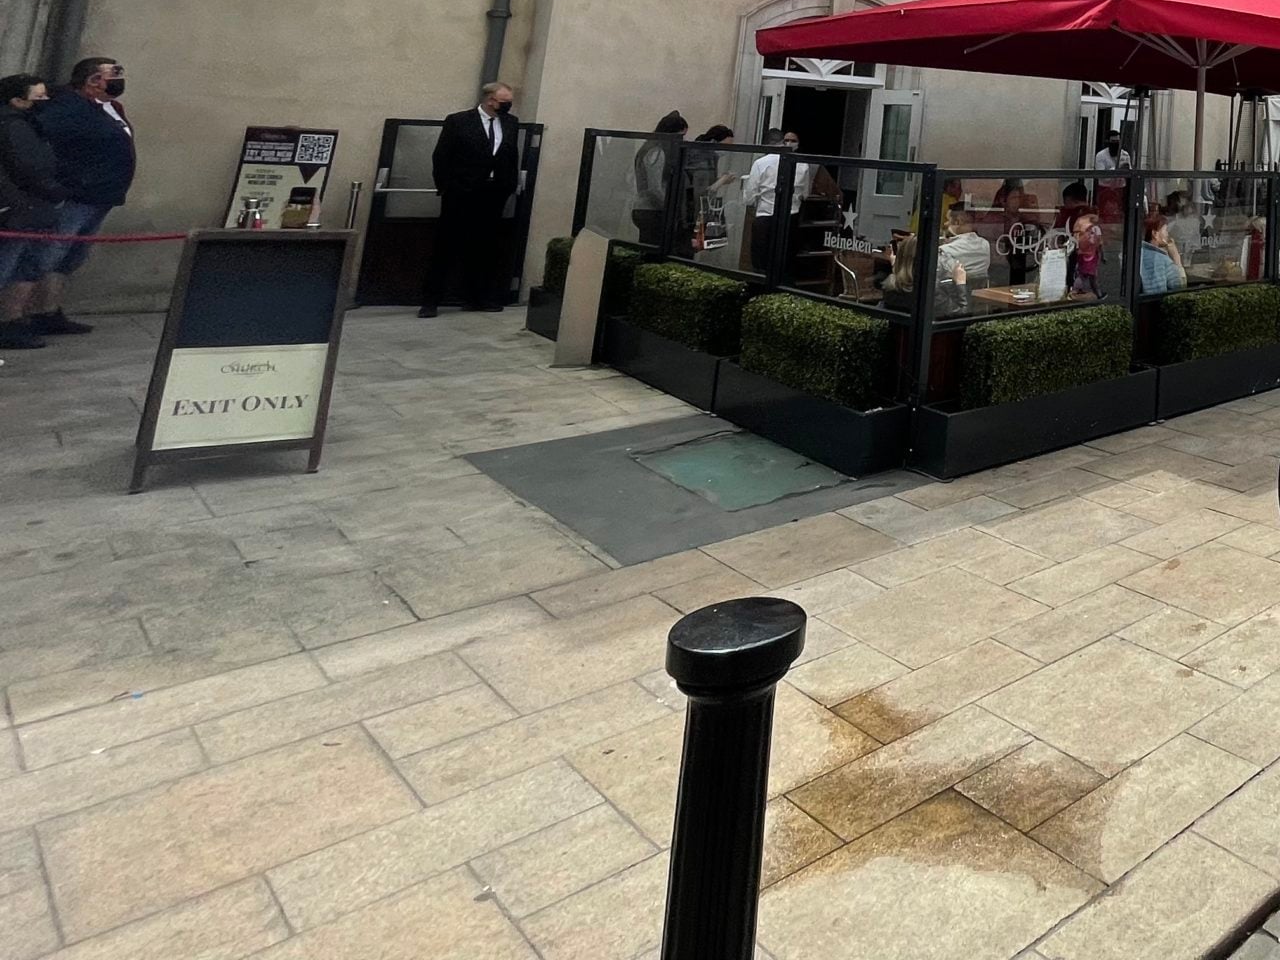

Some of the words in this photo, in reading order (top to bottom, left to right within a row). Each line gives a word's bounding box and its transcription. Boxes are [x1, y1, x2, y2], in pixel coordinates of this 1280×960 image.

[823, 231, 872, 254] Heineken
[172, 399, 236, 417] EXIT
[241, 394, 310, 412] ONLY
